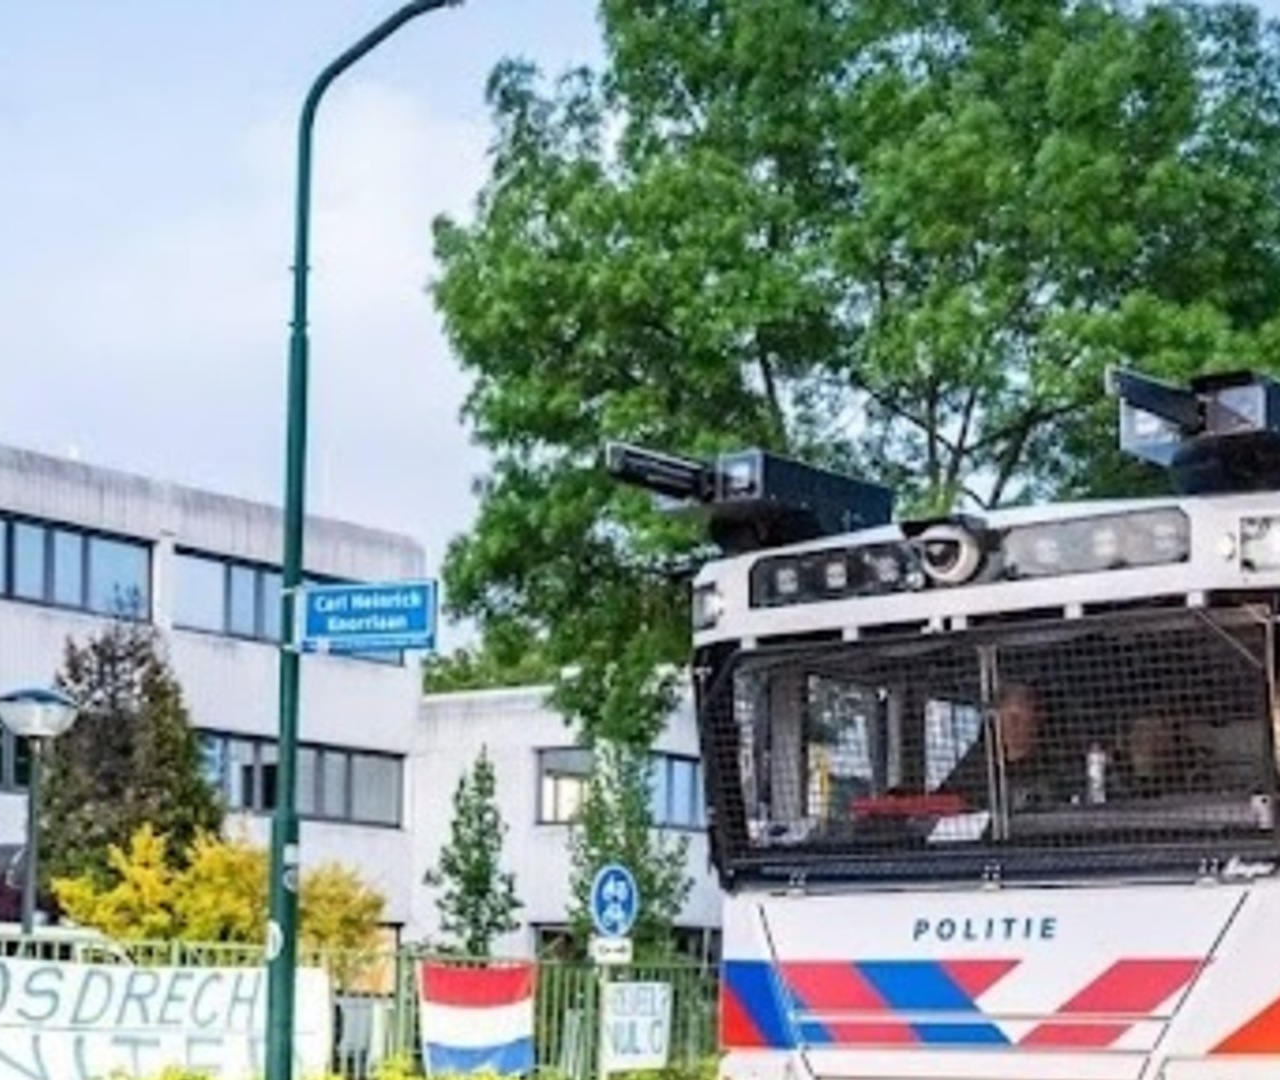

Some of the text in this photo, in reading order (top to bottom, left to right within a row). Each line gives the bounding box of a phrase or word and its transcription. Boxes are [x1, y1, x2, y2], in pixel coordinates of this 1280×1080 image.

[314, 590, 422, 613] Carl Heinrich
[327, 614, 408, 631] Knorrlaan
[913, 917, 1057, 941] POLITIE
